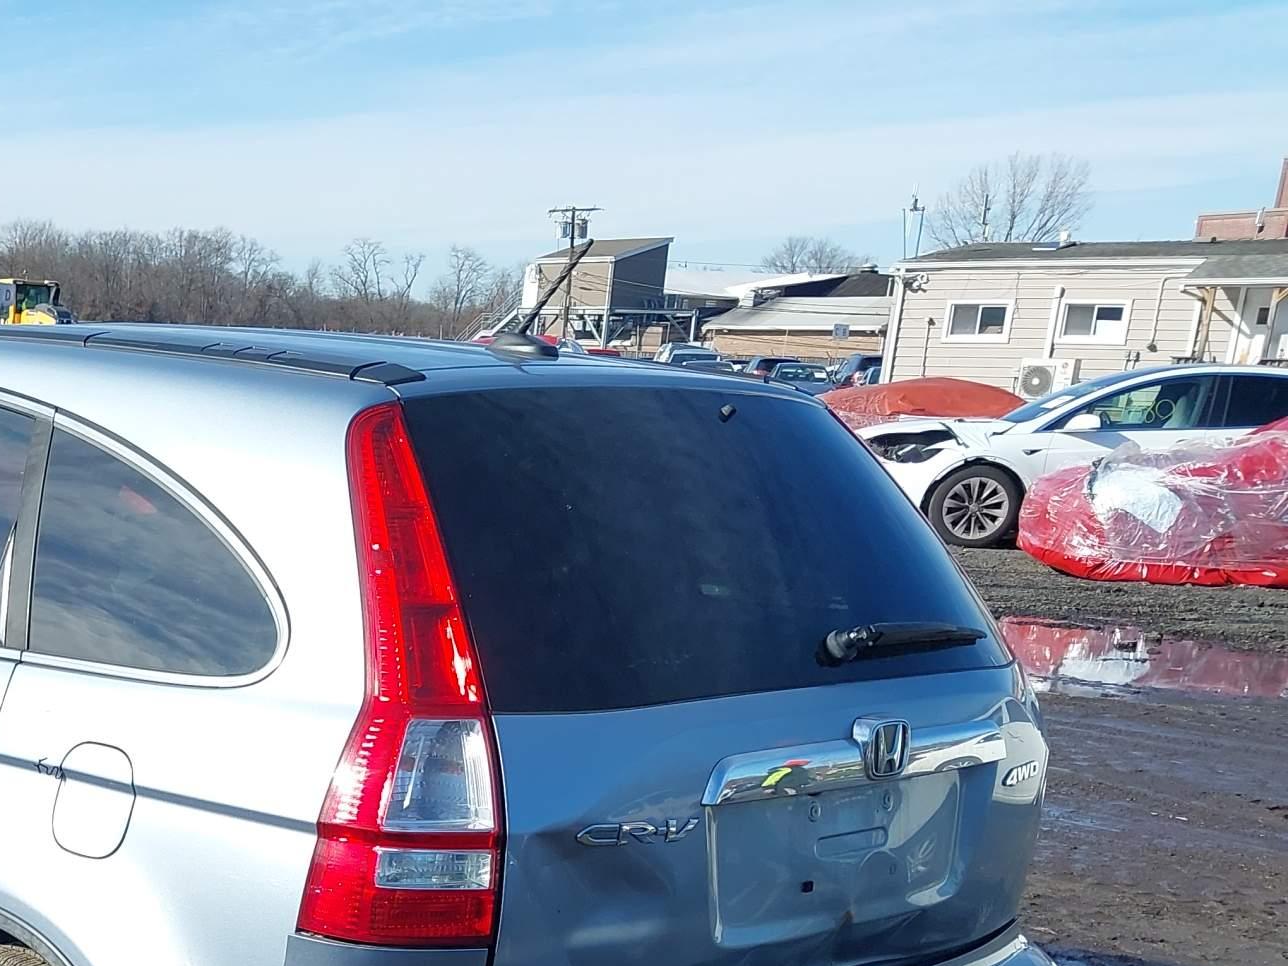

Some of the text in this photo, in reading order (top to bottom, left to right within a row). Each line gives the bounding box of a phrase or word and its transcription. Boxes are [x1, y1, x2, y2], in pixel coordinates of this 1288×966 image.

[5, 289, 11, 301] D
[1006, 761, 1039, 786] 4WD
[576, 818, 699, 847] CR-V
